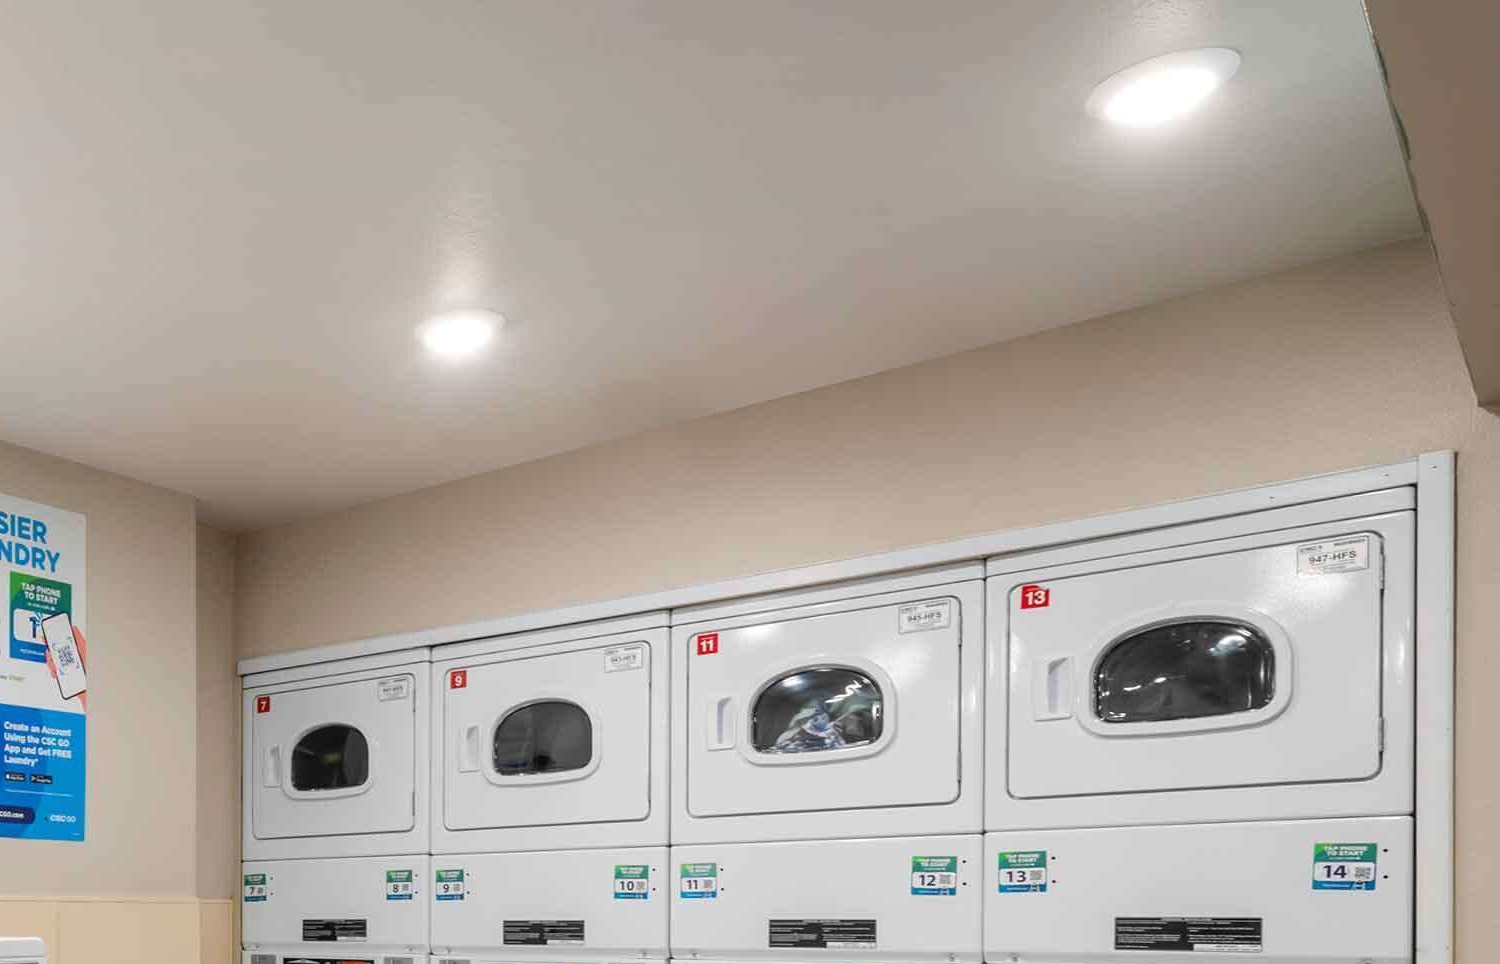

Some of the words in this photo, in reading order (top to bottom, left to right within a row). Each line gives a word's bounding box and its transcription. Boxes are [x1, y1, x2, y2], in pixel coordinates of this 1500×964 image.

[1309, 550, 1356, 562] 947-HFS
[21, 583, 35, 591] TAP
[36, 586, 61, 598] PHONE
[24, 592, 35, 600] TO
[36, 594, 58, 605] START
[1025, 590, 1046, 606] 13
[700, 640, 714, 652] 11
[454, 676, 462, 686] 9
[260, 702, 266, 710] 7
[4, 721, 29, 734] Create
[41, 728, 72, 740] Account
[4, 732, 26, 746] Using
[27, 734, 40, 744] the
[41, 738, 56, 748] CSC
[58, 740, 70, 749] GO
[4, 746, 21, 758] App
[22, 748, 37, 758] and
[38, 749, 50, 760] Get
[52, 750, 72, 762] FREE
[1006, 870, 1026, 882] 13
[1324, 864, 1347, 878] 14
[620, 881, 634, 891] 10
[686, 880, 698, 890] 11
[918, 874, 936, 886] 12
[250, 886, 254, 895] 7
[393, 884, 399, 893] 8
[443, 884, 450, 893] 9
